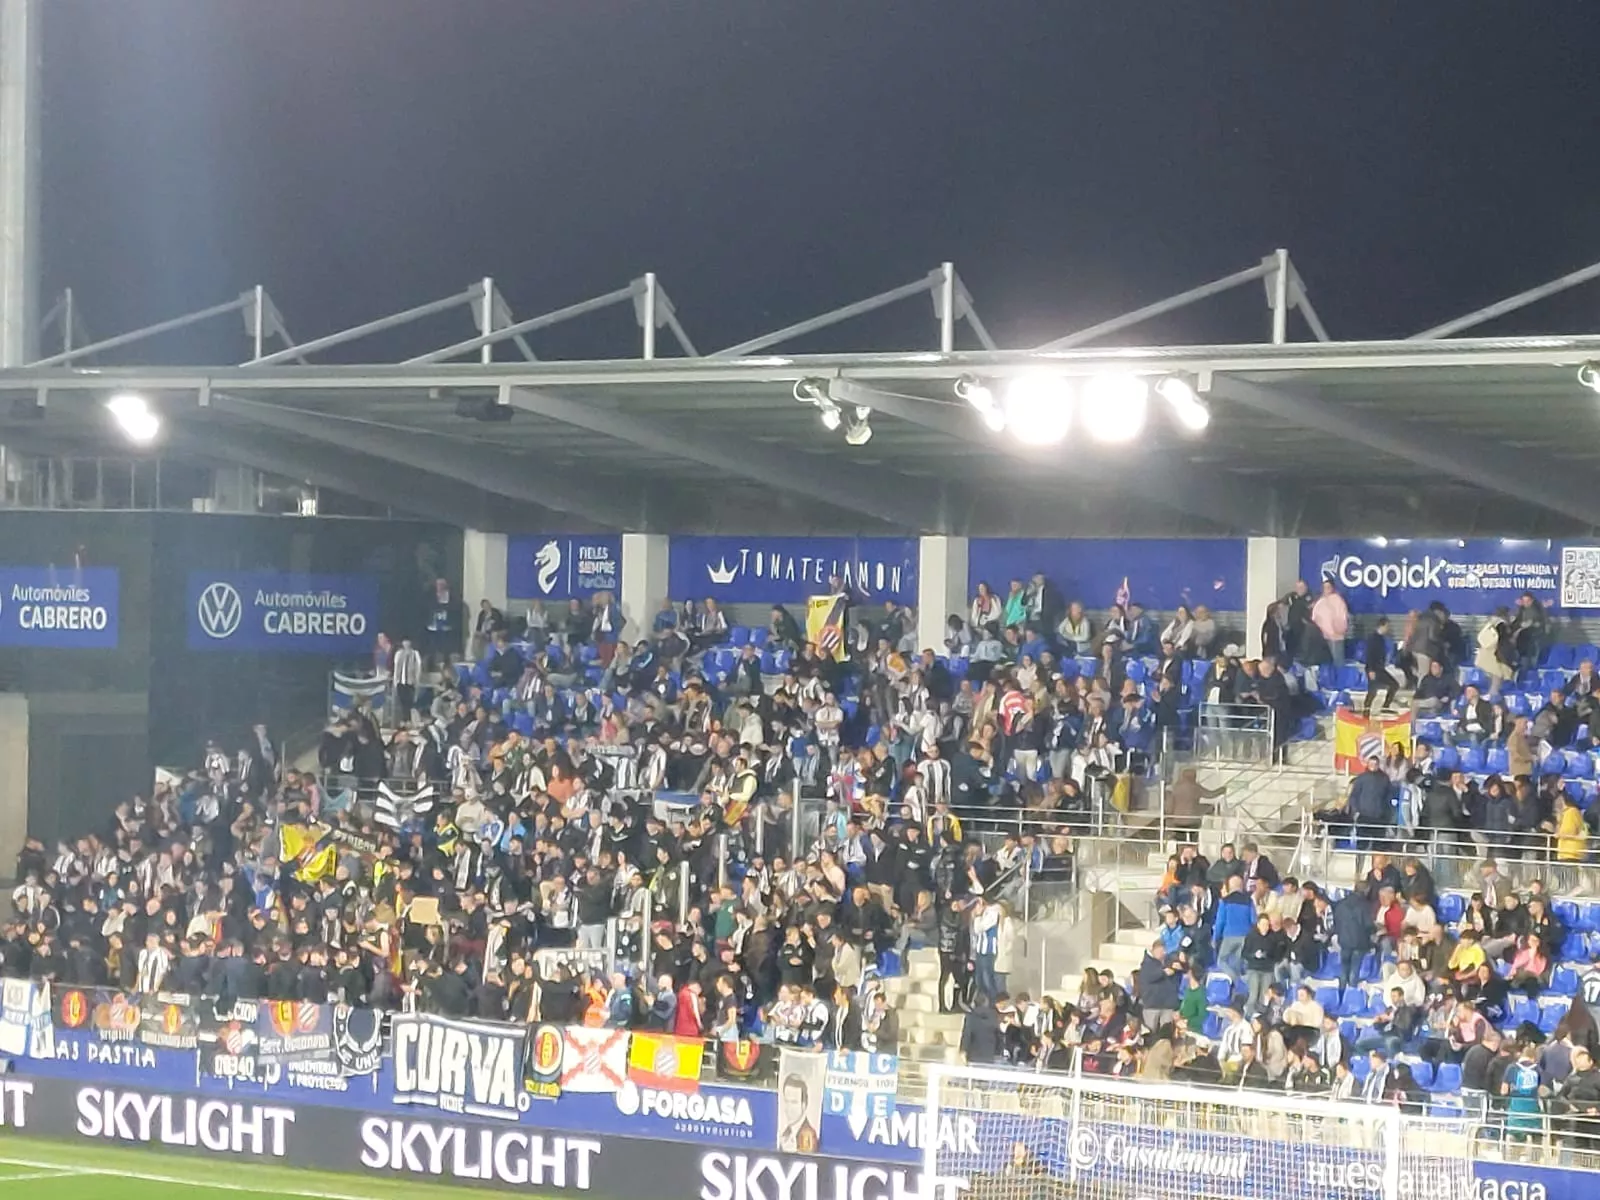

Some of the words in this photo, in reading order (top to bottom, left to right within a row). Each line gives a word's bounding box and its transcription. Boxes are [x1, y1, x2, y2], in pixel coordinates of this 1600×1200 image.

[1340, 555, 1445, 598] Gopick
[1501, 564, 1514, 576] TU
[1552, 565, 1559, 577] Y
[12, 584, 90, 602] Automóviles
[254, 589, 347, 609] Automóviles
[19, 606, 108, 631] CABRERO
[263, 611, 366, 636] CABRERO
[395, 1022, 515, 1108] CURVA
[642, 1088, 753, 1126] FORGASA
[831, 1091, 845, 1112] D
[76, 1087, 296, 1156] SKYLIGHT
[868, 1111, 981, 1153] AMBAR
[360, 1117, 601, 1190] SKYLIGHT
